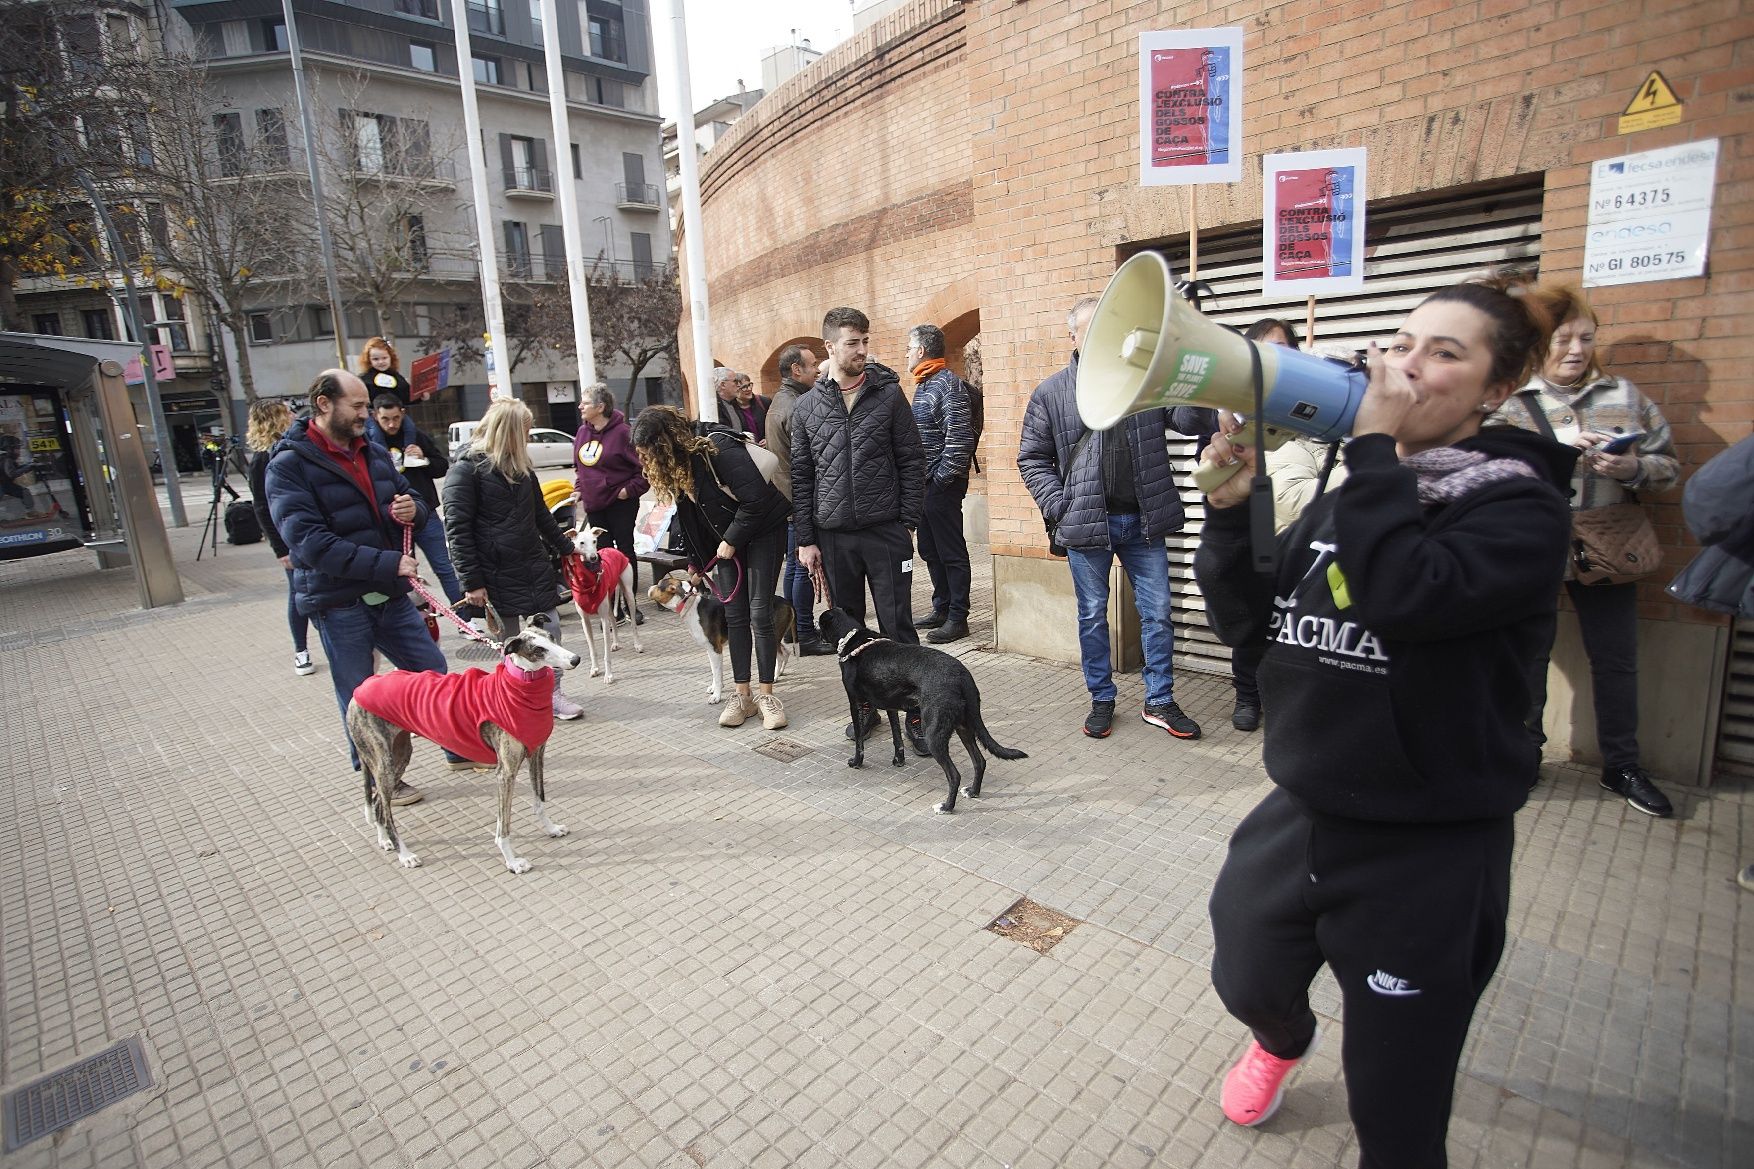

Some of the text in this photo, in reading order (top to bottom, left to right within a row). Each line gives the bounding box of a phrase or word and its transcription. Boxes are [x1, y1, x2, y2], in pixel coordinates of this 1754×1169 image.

[1155, 89, 1206, 99] CONTRA
[1155, 96, 1223, 108] L'EXCLUSIÓ
[1155, 109, 1186, 118] DELS
[1155, 117, 1205, 126] GOSSOS
[1155, 127, 1171, 136] DE
[1155, 136, 1189, 146] CAÇA
[1627, 160, 1663, 174] fecsa
[1664, 151, 1715, 168] endesa
[1614, 188, 1671, 209] 64375
[1278, 207, 1330, 218] CONTRA
[1278, 212, 1346, 226] L'EXCLUSIÓ
[1279, 225, 1310, 235] DELS
[1591, 222, 1672, 242] endesa
[1279, 232, 1328, 243] GOSSOS
[1279, 243, 1296, 251] DE
[1278, 250, 1313, 261] CAÇA
[1608, 258, 1623, 271] GI
[1630, 251, 1685, 269] 80575
[1179, 354, 1211, 375] SAVE
[1164, 382, 1199, 398] SAVE
[1265, 611, 1390, 661] PACMA
[1318, 656, 1388, 675] www.pacma.es
[1373, 969, 1409, 991] NIKE
